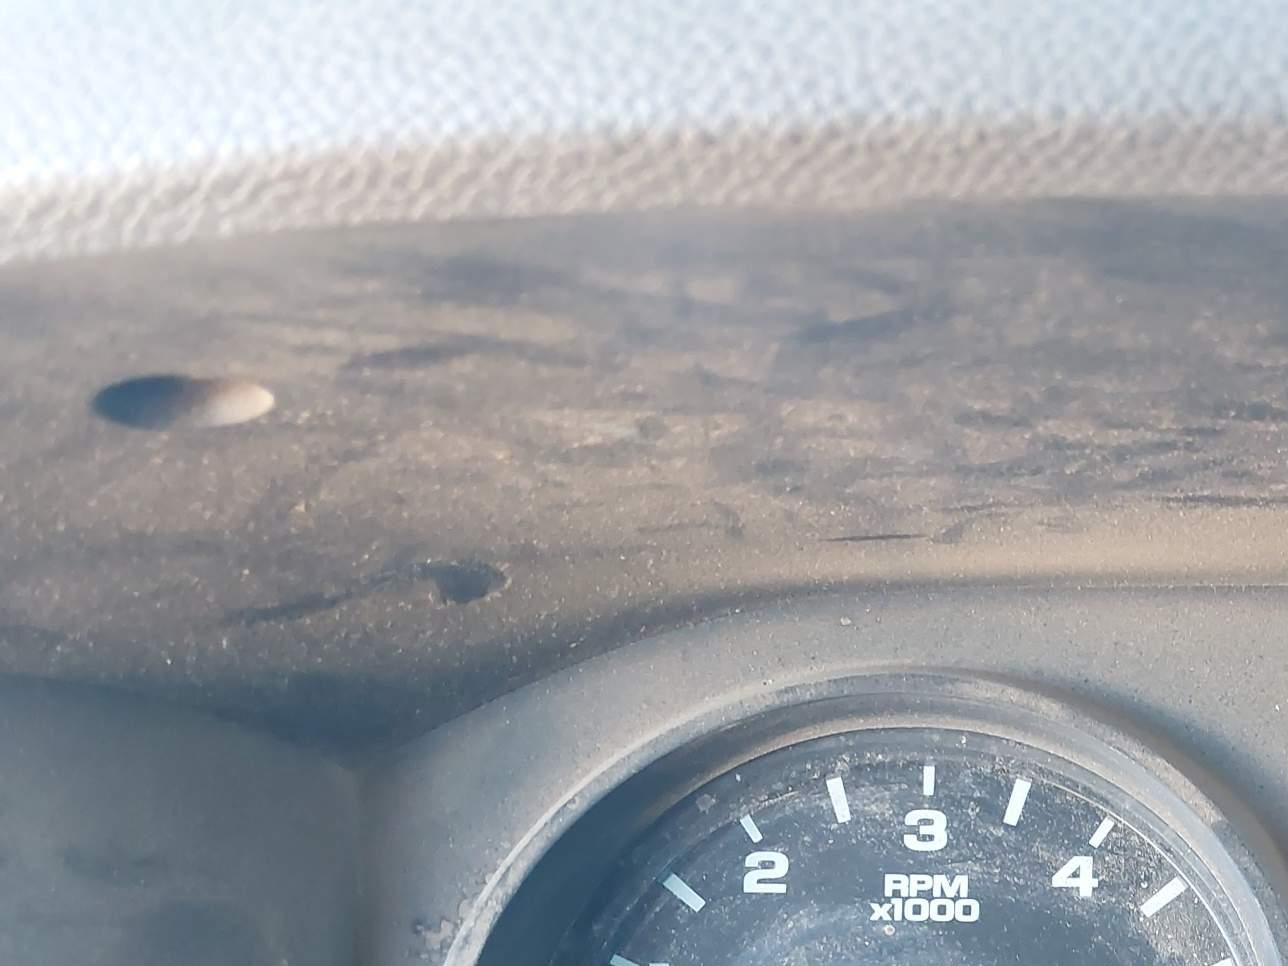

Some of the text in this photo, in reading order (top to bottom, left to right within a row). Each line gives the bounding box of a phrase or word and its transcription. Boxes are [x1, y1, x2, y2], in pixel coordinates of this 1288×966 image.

[903, 809, 948, 851] 3
[743, 851, 790, 894] 2
[884, 874, 969, 898] RPM
[1051, 855, 1099, 897] 4
[869, 898, 980, 922] x1000
